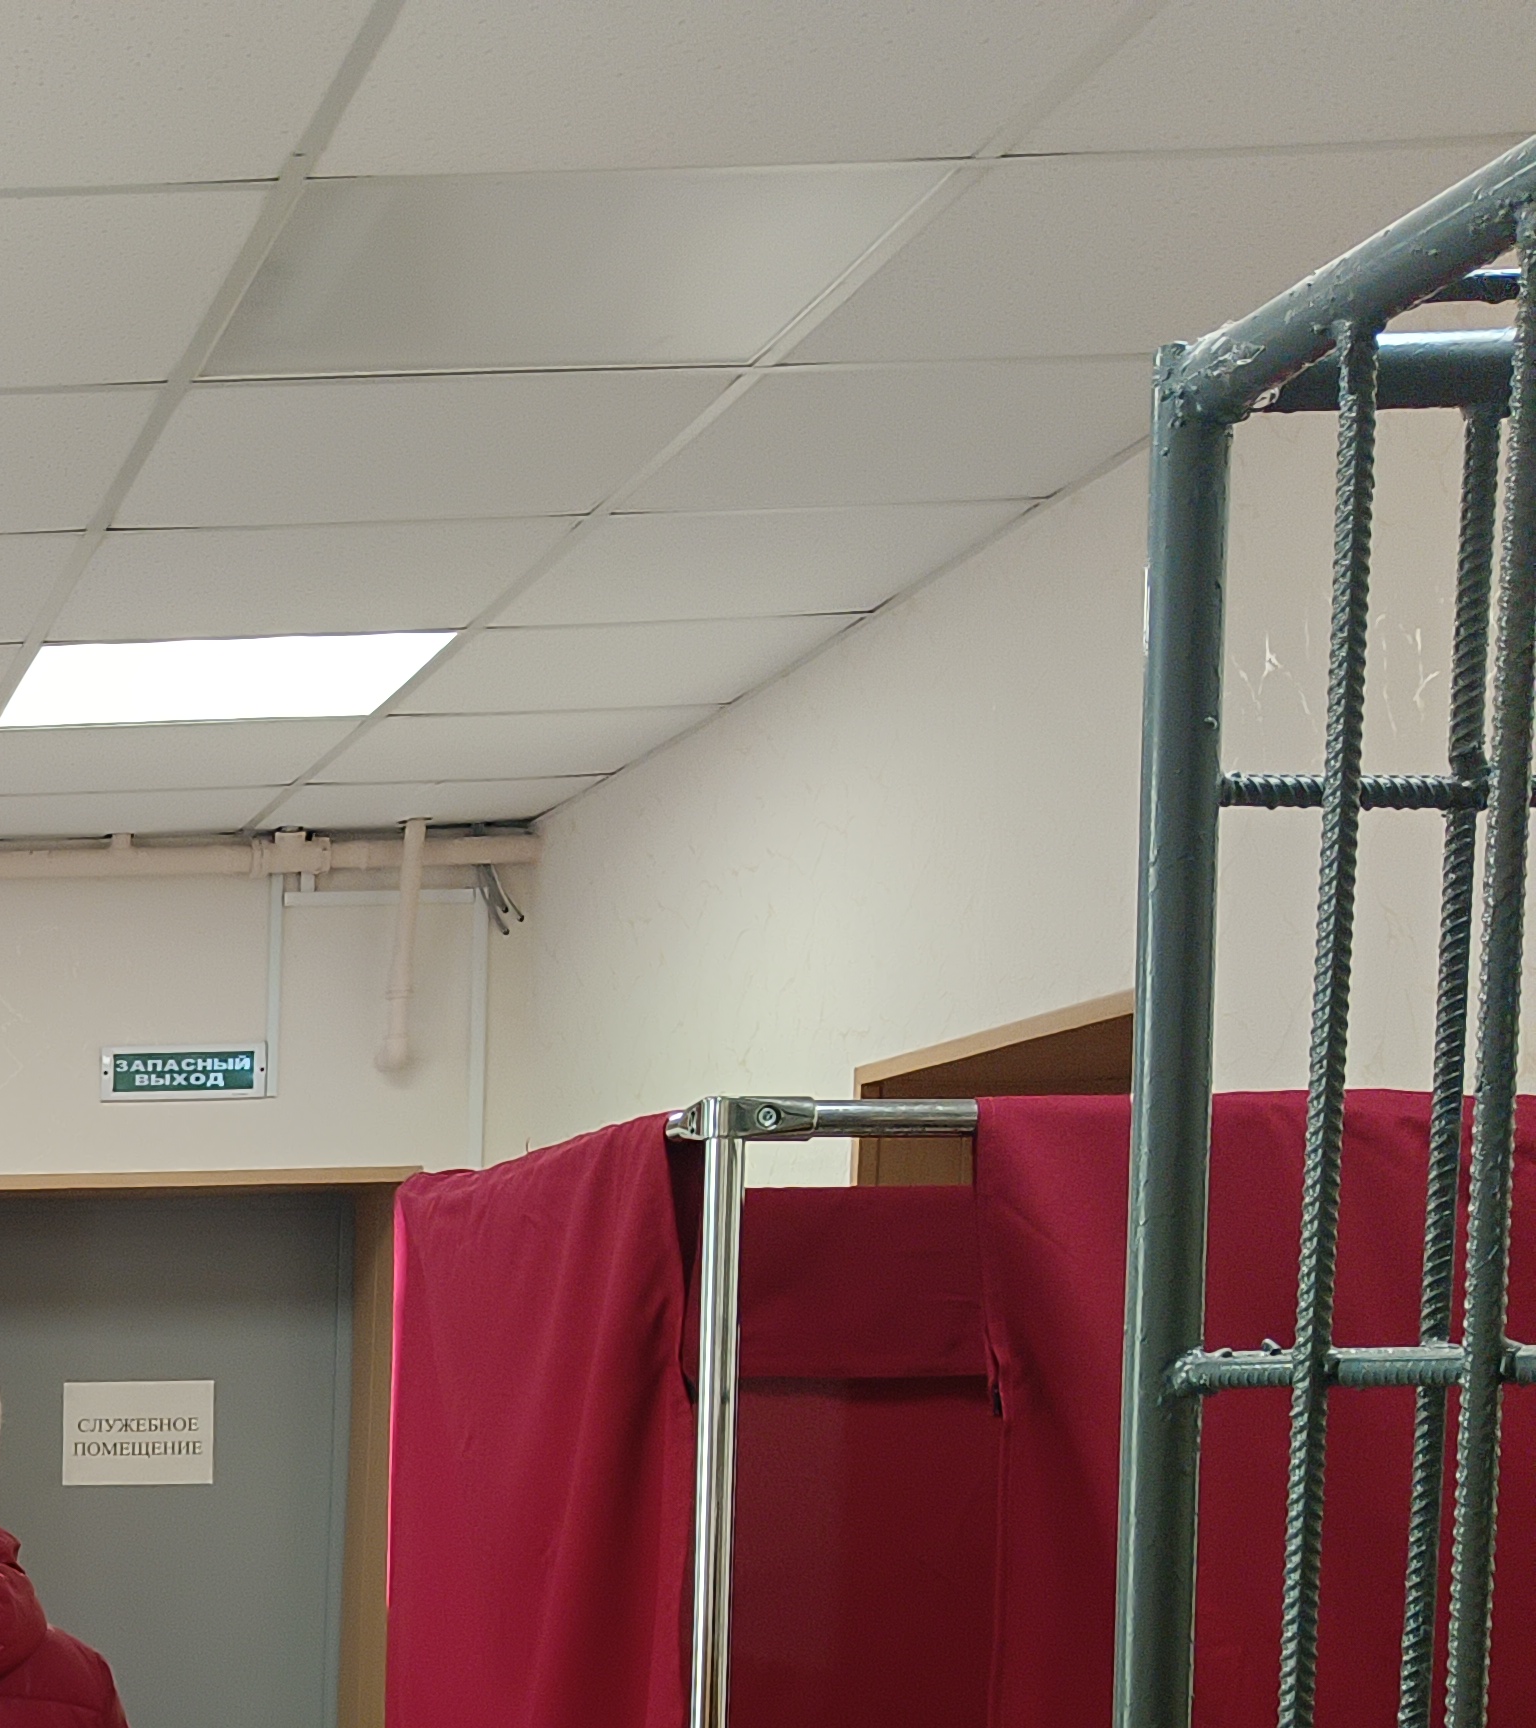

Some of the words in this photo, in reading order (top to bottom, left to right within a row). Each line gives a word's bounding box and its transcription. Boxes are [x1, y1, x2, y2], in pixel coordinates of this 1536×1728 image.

[115, 1055, 252, 1072] ЗАПАСНЫЙ
[134, 1072, 225, 1087] ВЫХОД
[77, 1416, 200, 1433] СЛУЖЕБНОЕ
[72, 1440, 204, 1459] ПОМЕЩЕНИЕ
